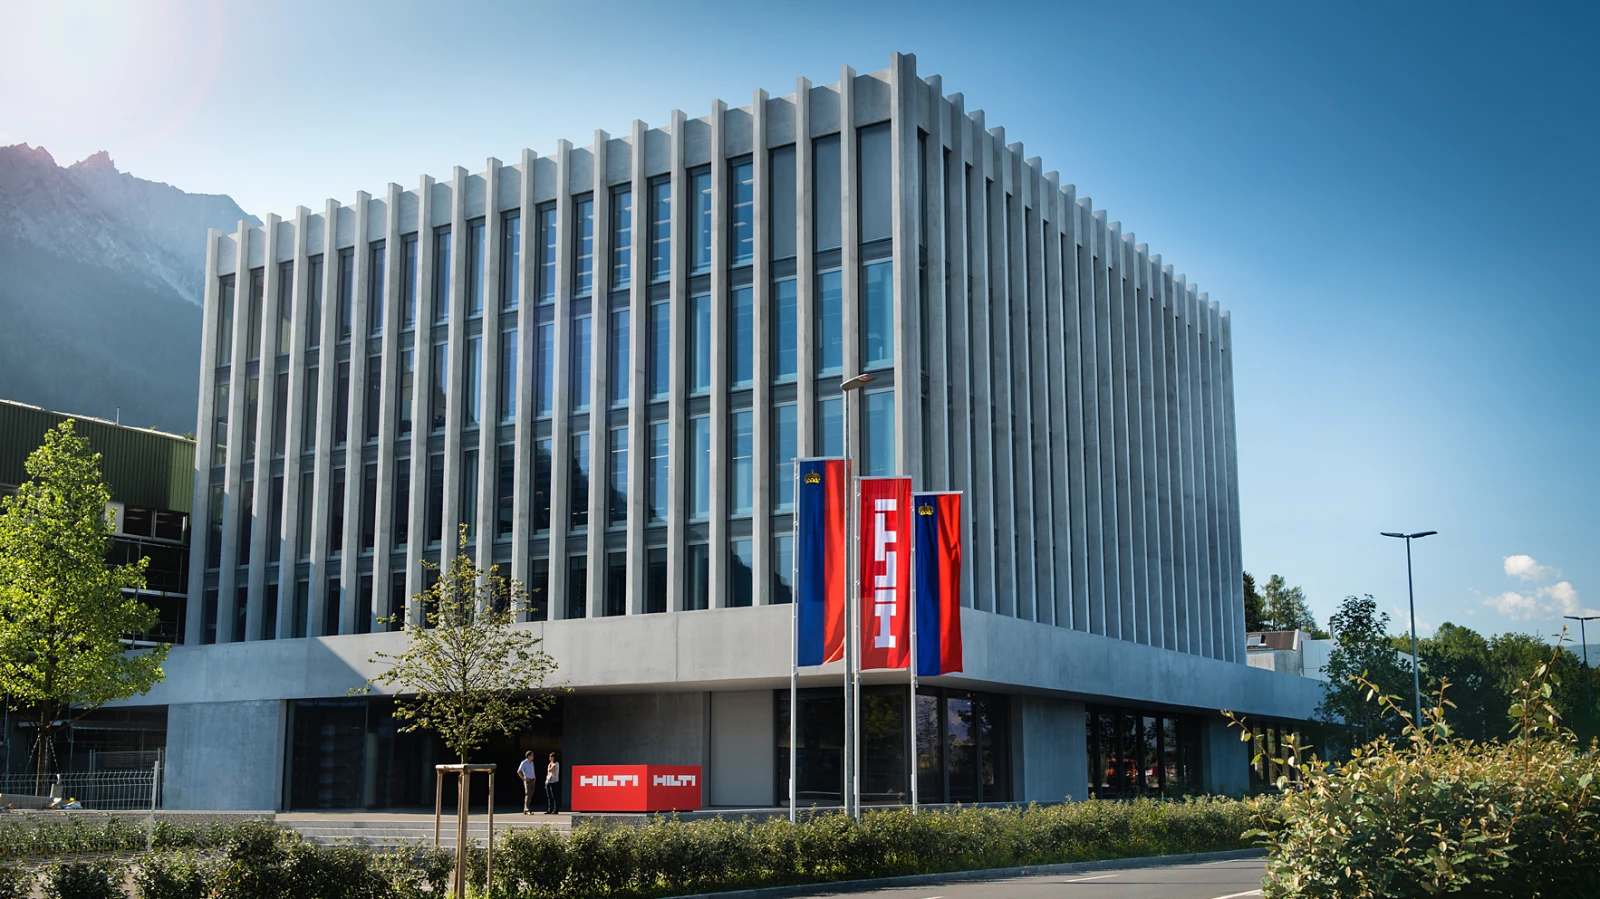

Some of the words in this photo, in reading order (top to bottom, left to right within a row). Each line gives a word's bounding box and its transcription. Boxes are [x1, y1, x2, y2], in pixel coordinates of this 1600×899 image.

[875, 499, 897, 648] HILTI
[580, 775, 639, 787] HILTI
[653, 775, 696, 787] HILTI
